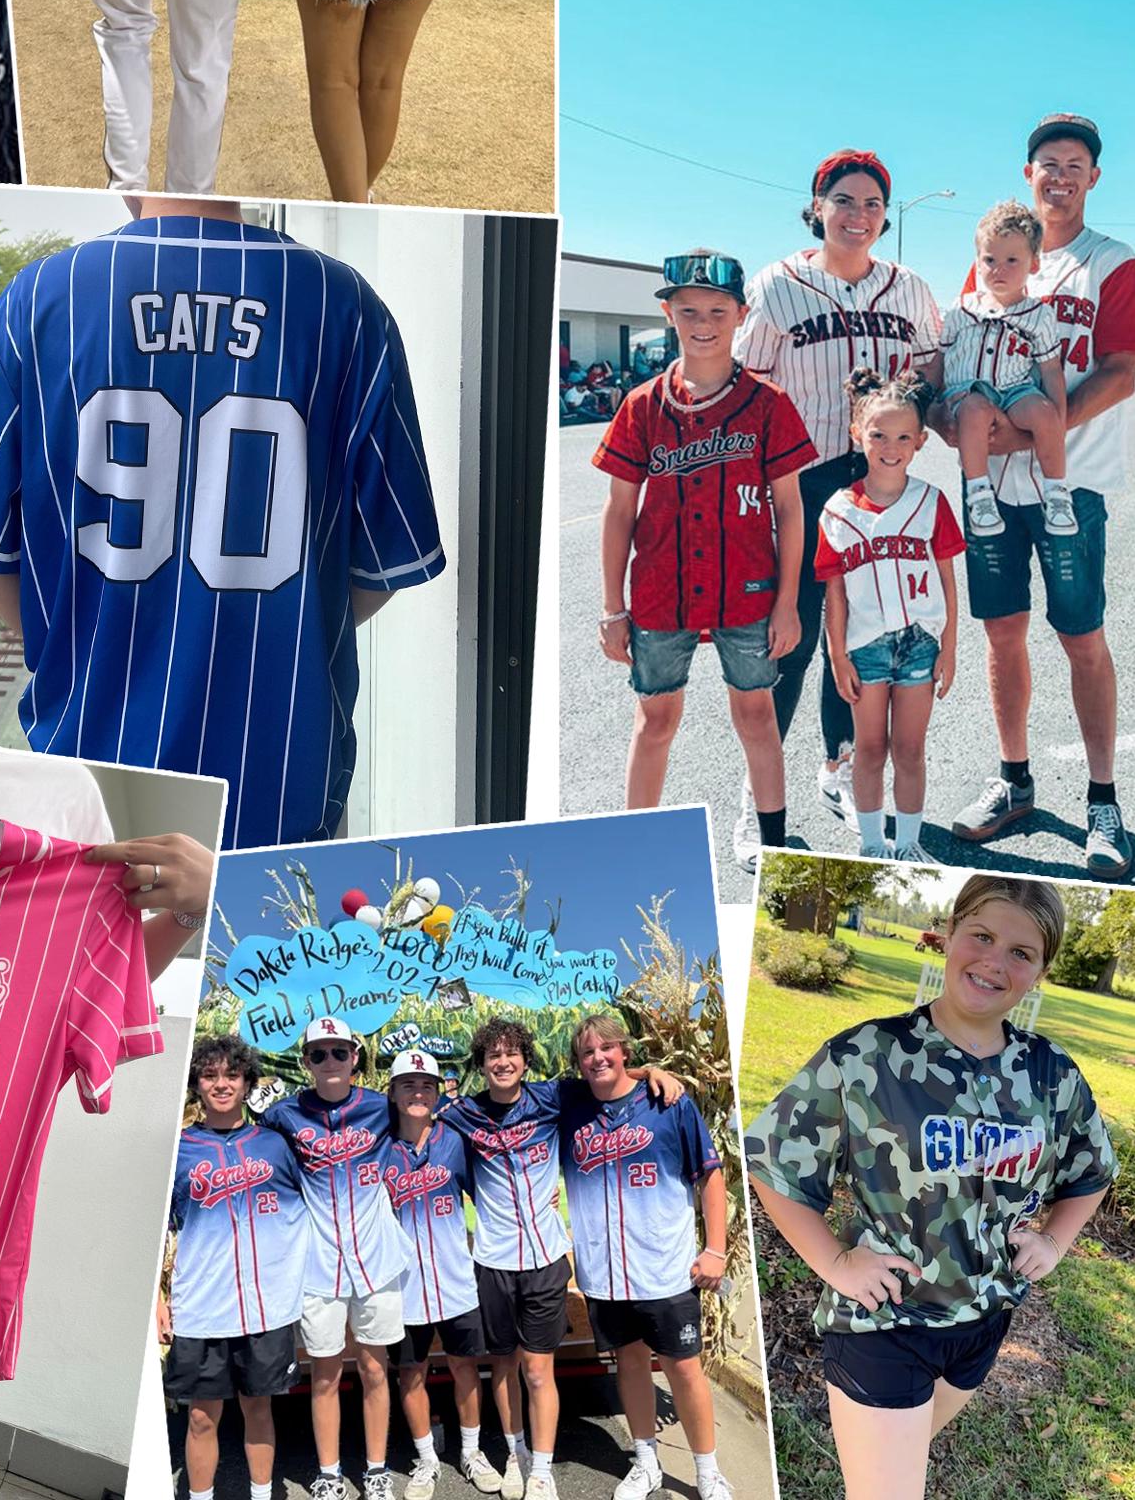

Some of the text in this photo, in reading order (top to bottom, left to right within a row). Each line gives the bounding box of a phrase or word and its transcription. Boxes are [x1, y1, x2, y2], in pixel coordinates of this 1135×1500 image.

[129, 290, 268, 360] CATS
[76, 385, 310, 594] 90
[736, 484, 761, 516] 14
[246, 984, 399, 1043] Field of Dreams
[526, 1140, 550, 1165] 25
[572, 1122, 655, 1165] Senior
[921, 1114, 1045, 1188] GLORY
[189, 1156, 274, 1202] Senior
[356, 1162, 381, 1187] 25
[627, 1162, 658, 1189] 25
[256, 1191, 280, 1214] 25
[433, 1195, 454, 1218] 25
